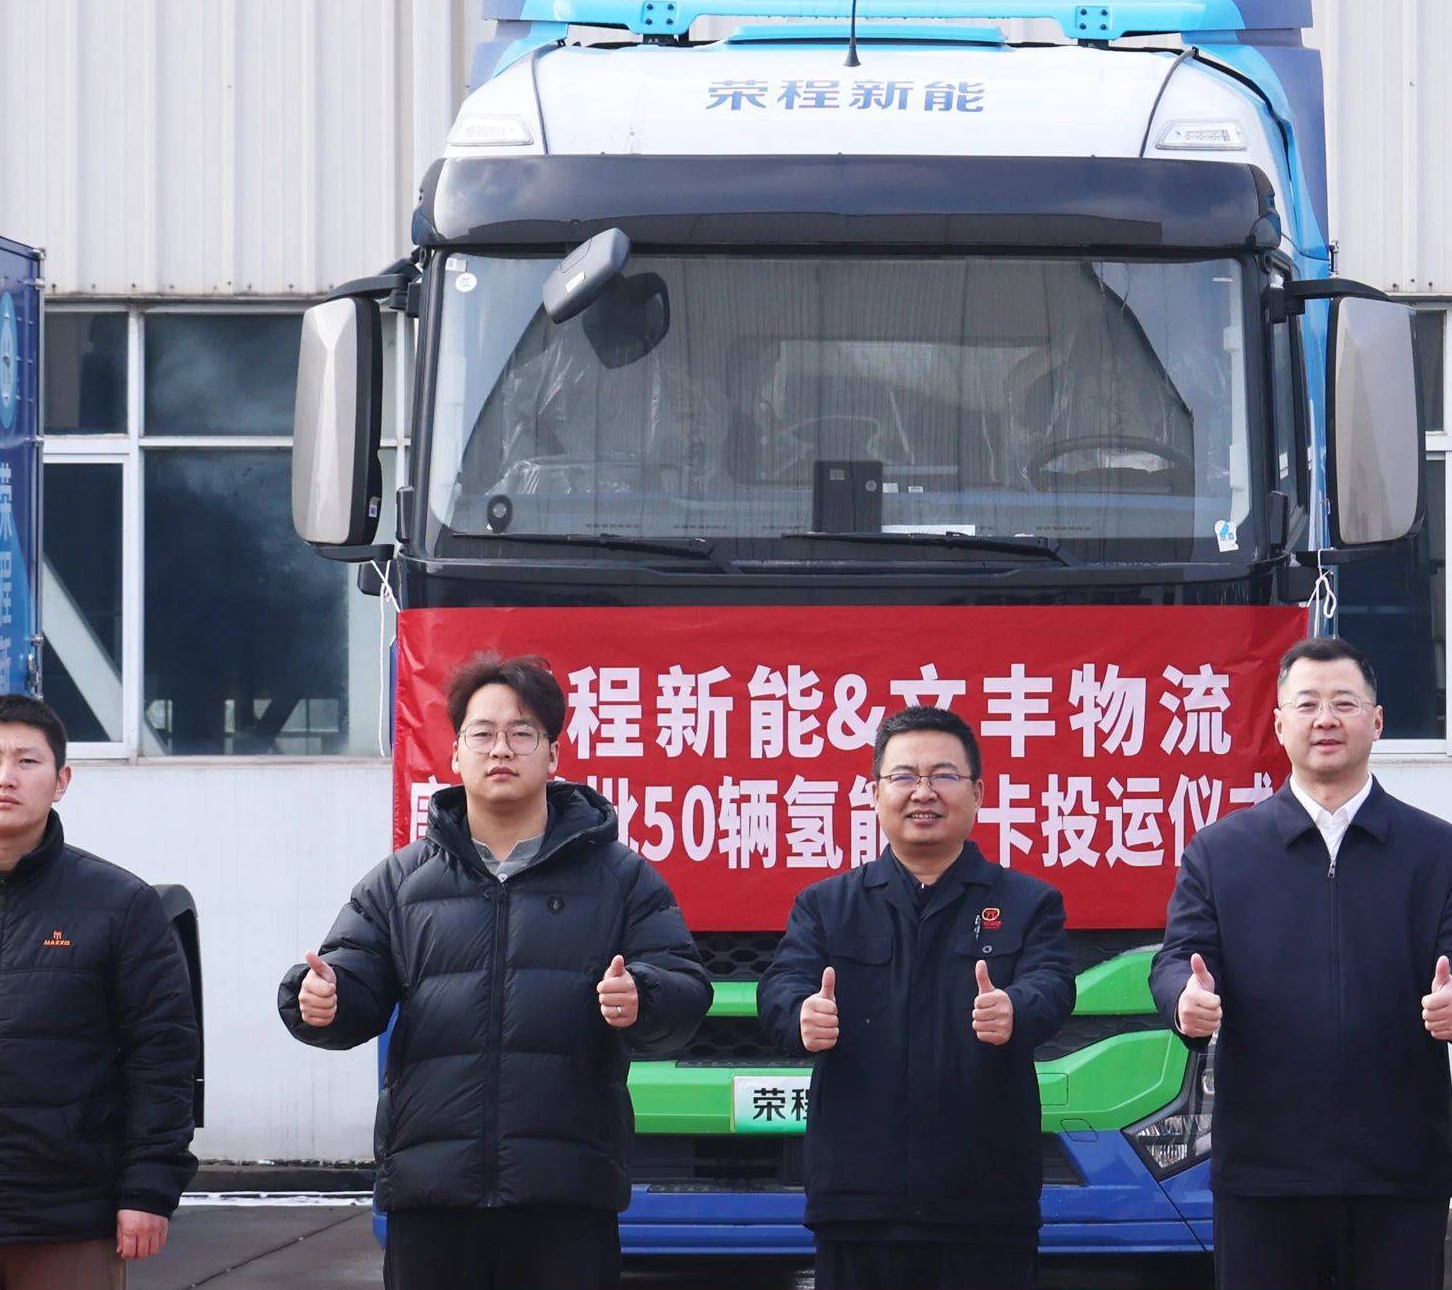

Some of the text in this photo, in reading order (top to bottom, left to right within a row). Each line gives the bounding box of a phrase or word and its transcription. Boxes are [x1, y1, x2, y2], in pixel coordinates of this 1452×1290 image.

[706, 79, 985, 114] 荣程新能
[548, 663, 1233, 760] 程新能&文丰物流
[752, 1087, 810, 1122] 荣程
